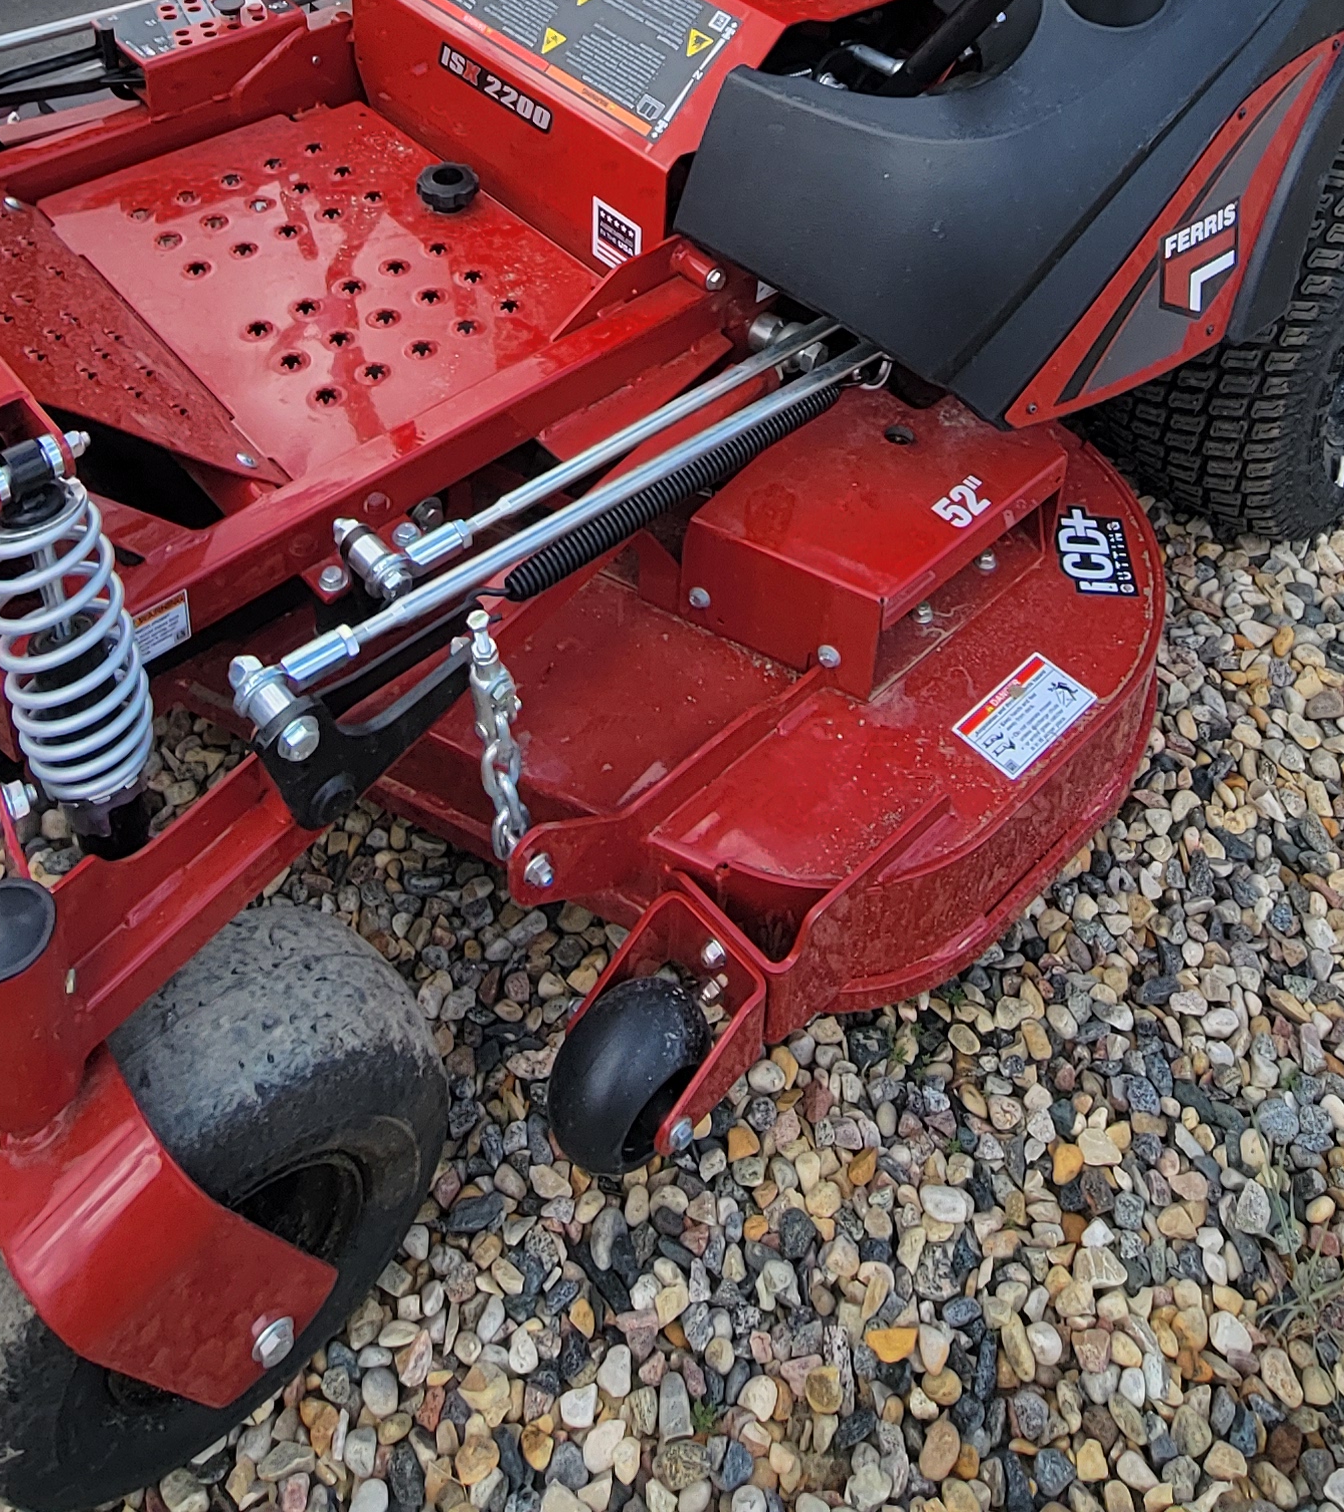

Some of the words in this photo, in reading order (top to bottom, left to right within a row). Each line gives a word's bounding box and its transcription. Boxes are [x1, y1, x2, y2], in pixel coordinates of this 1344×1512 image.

[441, 45, 481, 87] ISX
[484, 74, 551, 130] 2200
[1164, 202, 1237, 259] FERRIS
[931, 474, 992, 528] 52"
[1107, 520, 1135, 594] CUTTING
